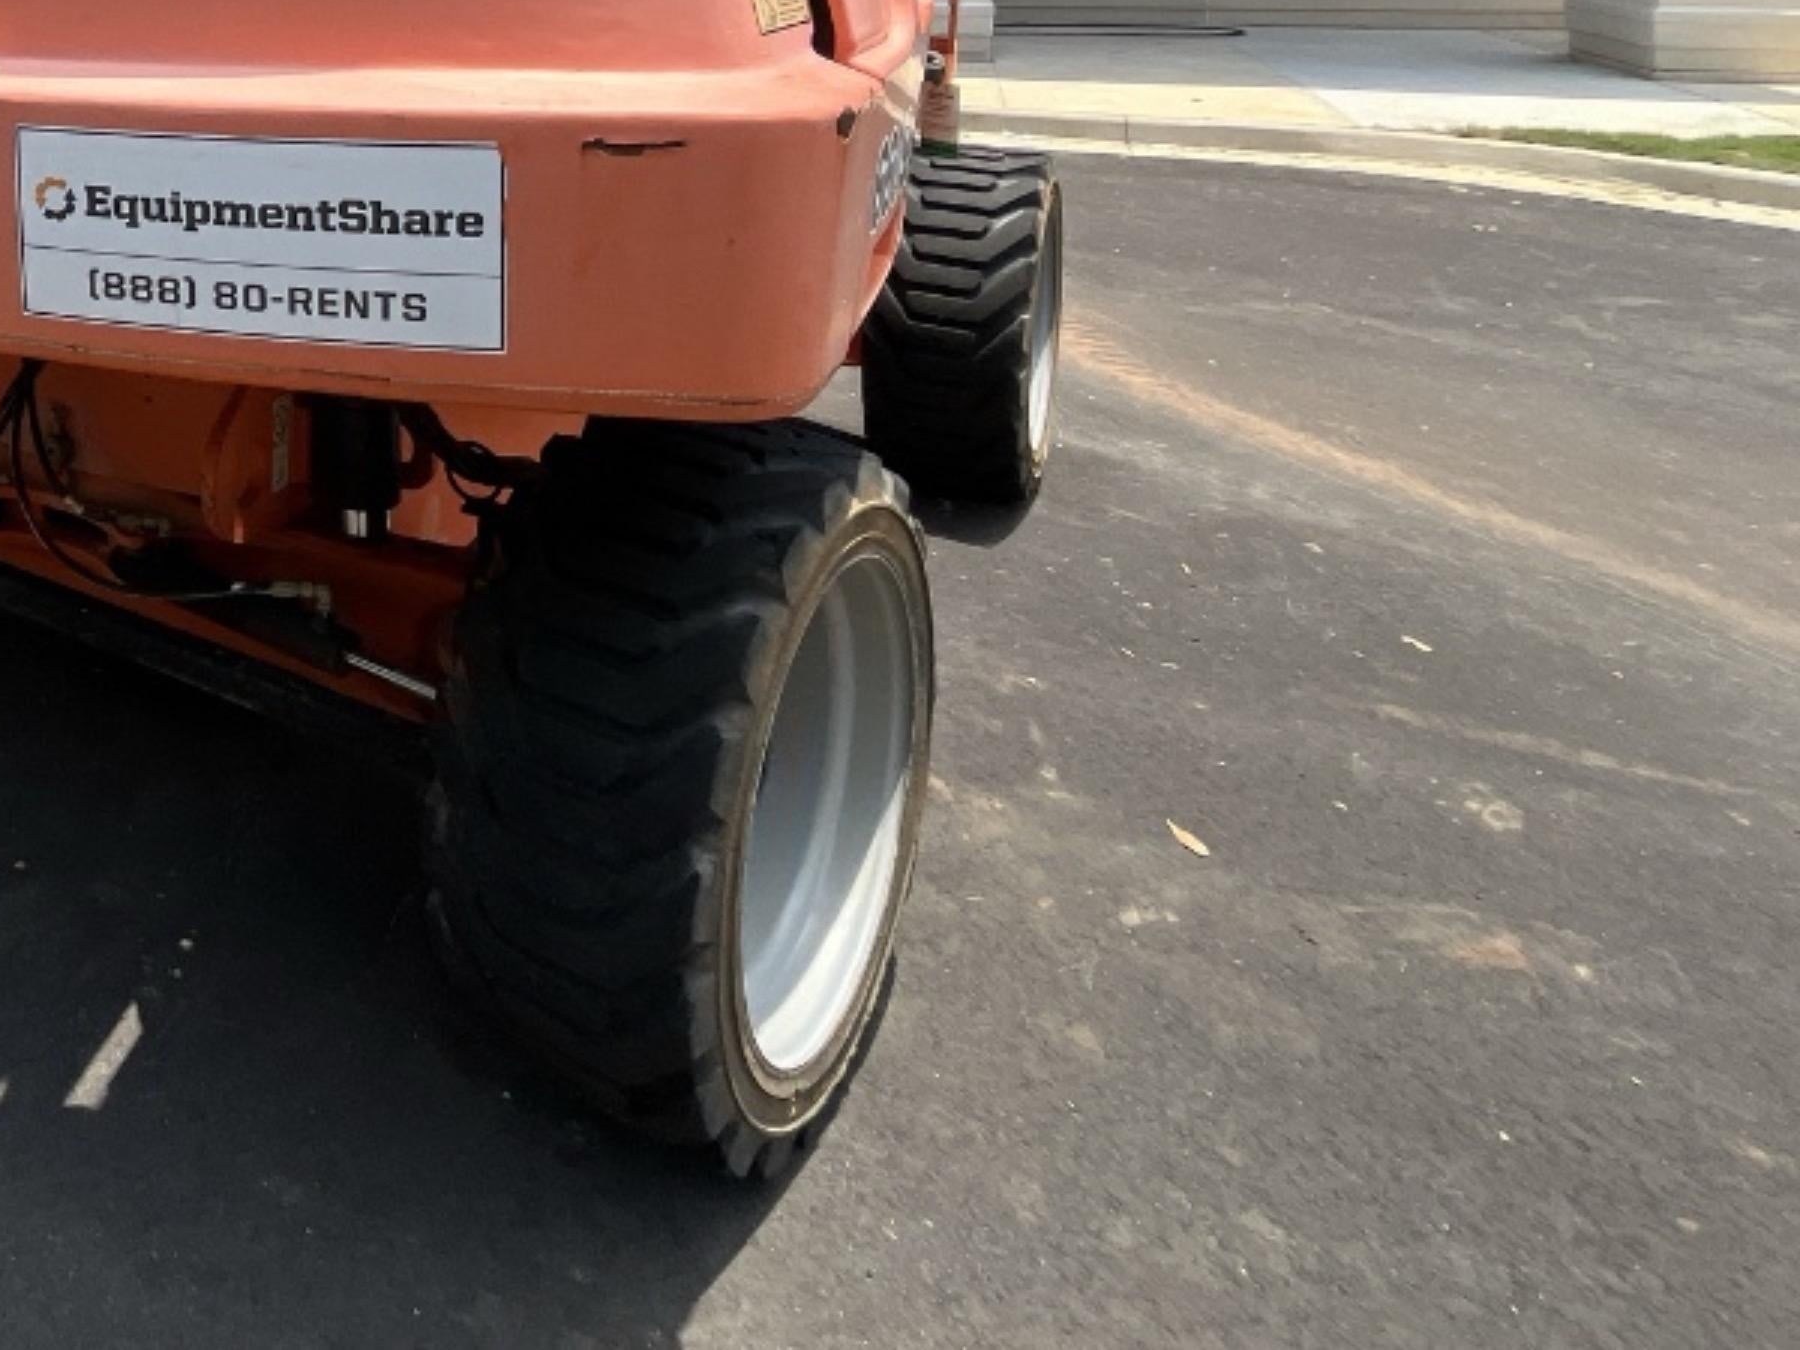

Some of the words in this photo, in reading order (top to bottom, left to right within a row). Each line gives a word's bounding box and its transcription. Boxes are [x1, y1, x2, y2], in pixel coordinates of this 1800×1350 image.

[83, 184, 485, 238] EquipmentShare
[89, 268, 197, 309] (888)
[213, 281, 429, 323] 80-RENTS
